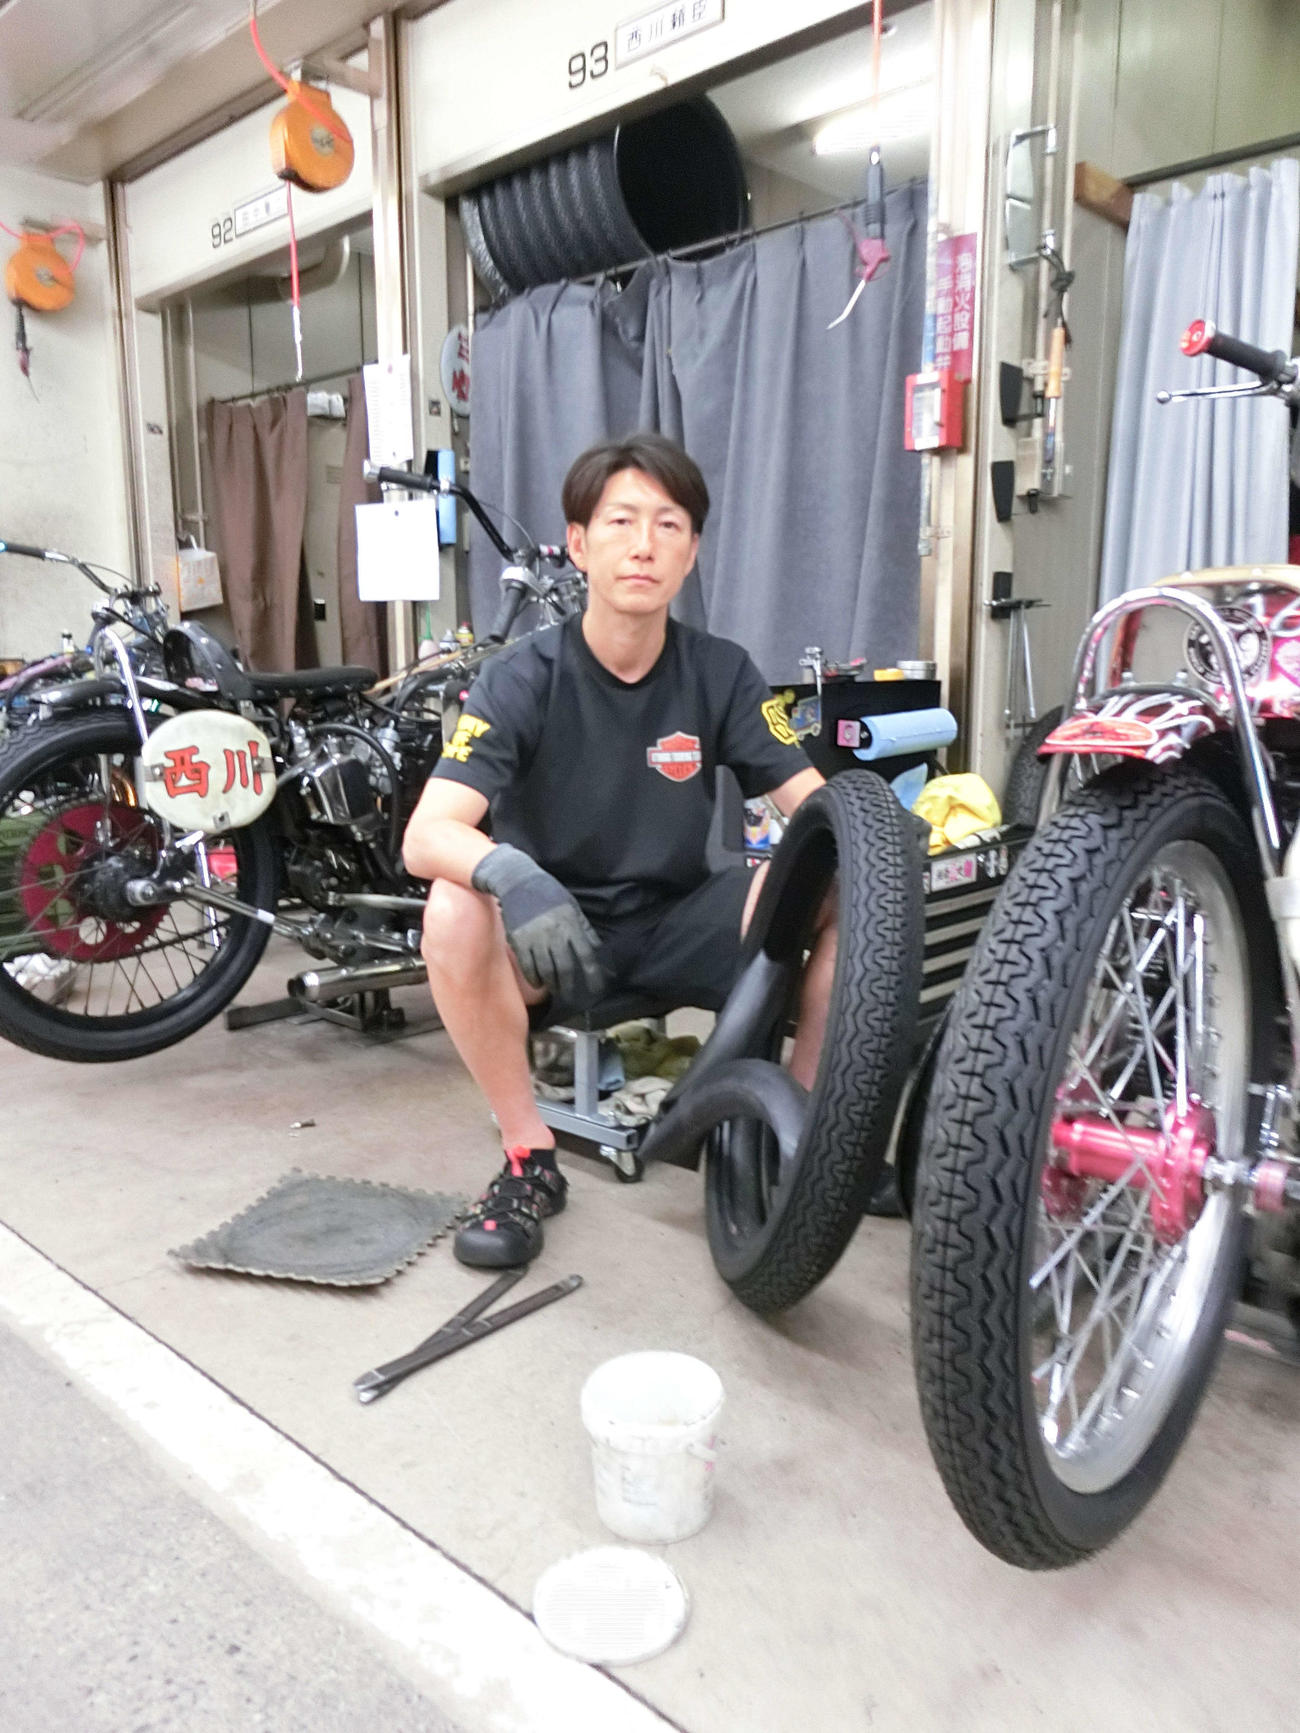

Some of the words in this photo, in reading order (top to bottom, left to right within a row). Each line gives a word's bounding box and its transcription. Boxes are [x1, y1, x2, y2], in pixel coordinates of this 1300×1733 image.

[568, 41, 609, 89] 93
[211, 216, 234, 249] 92
[164, 740, 264, 799] 西川
